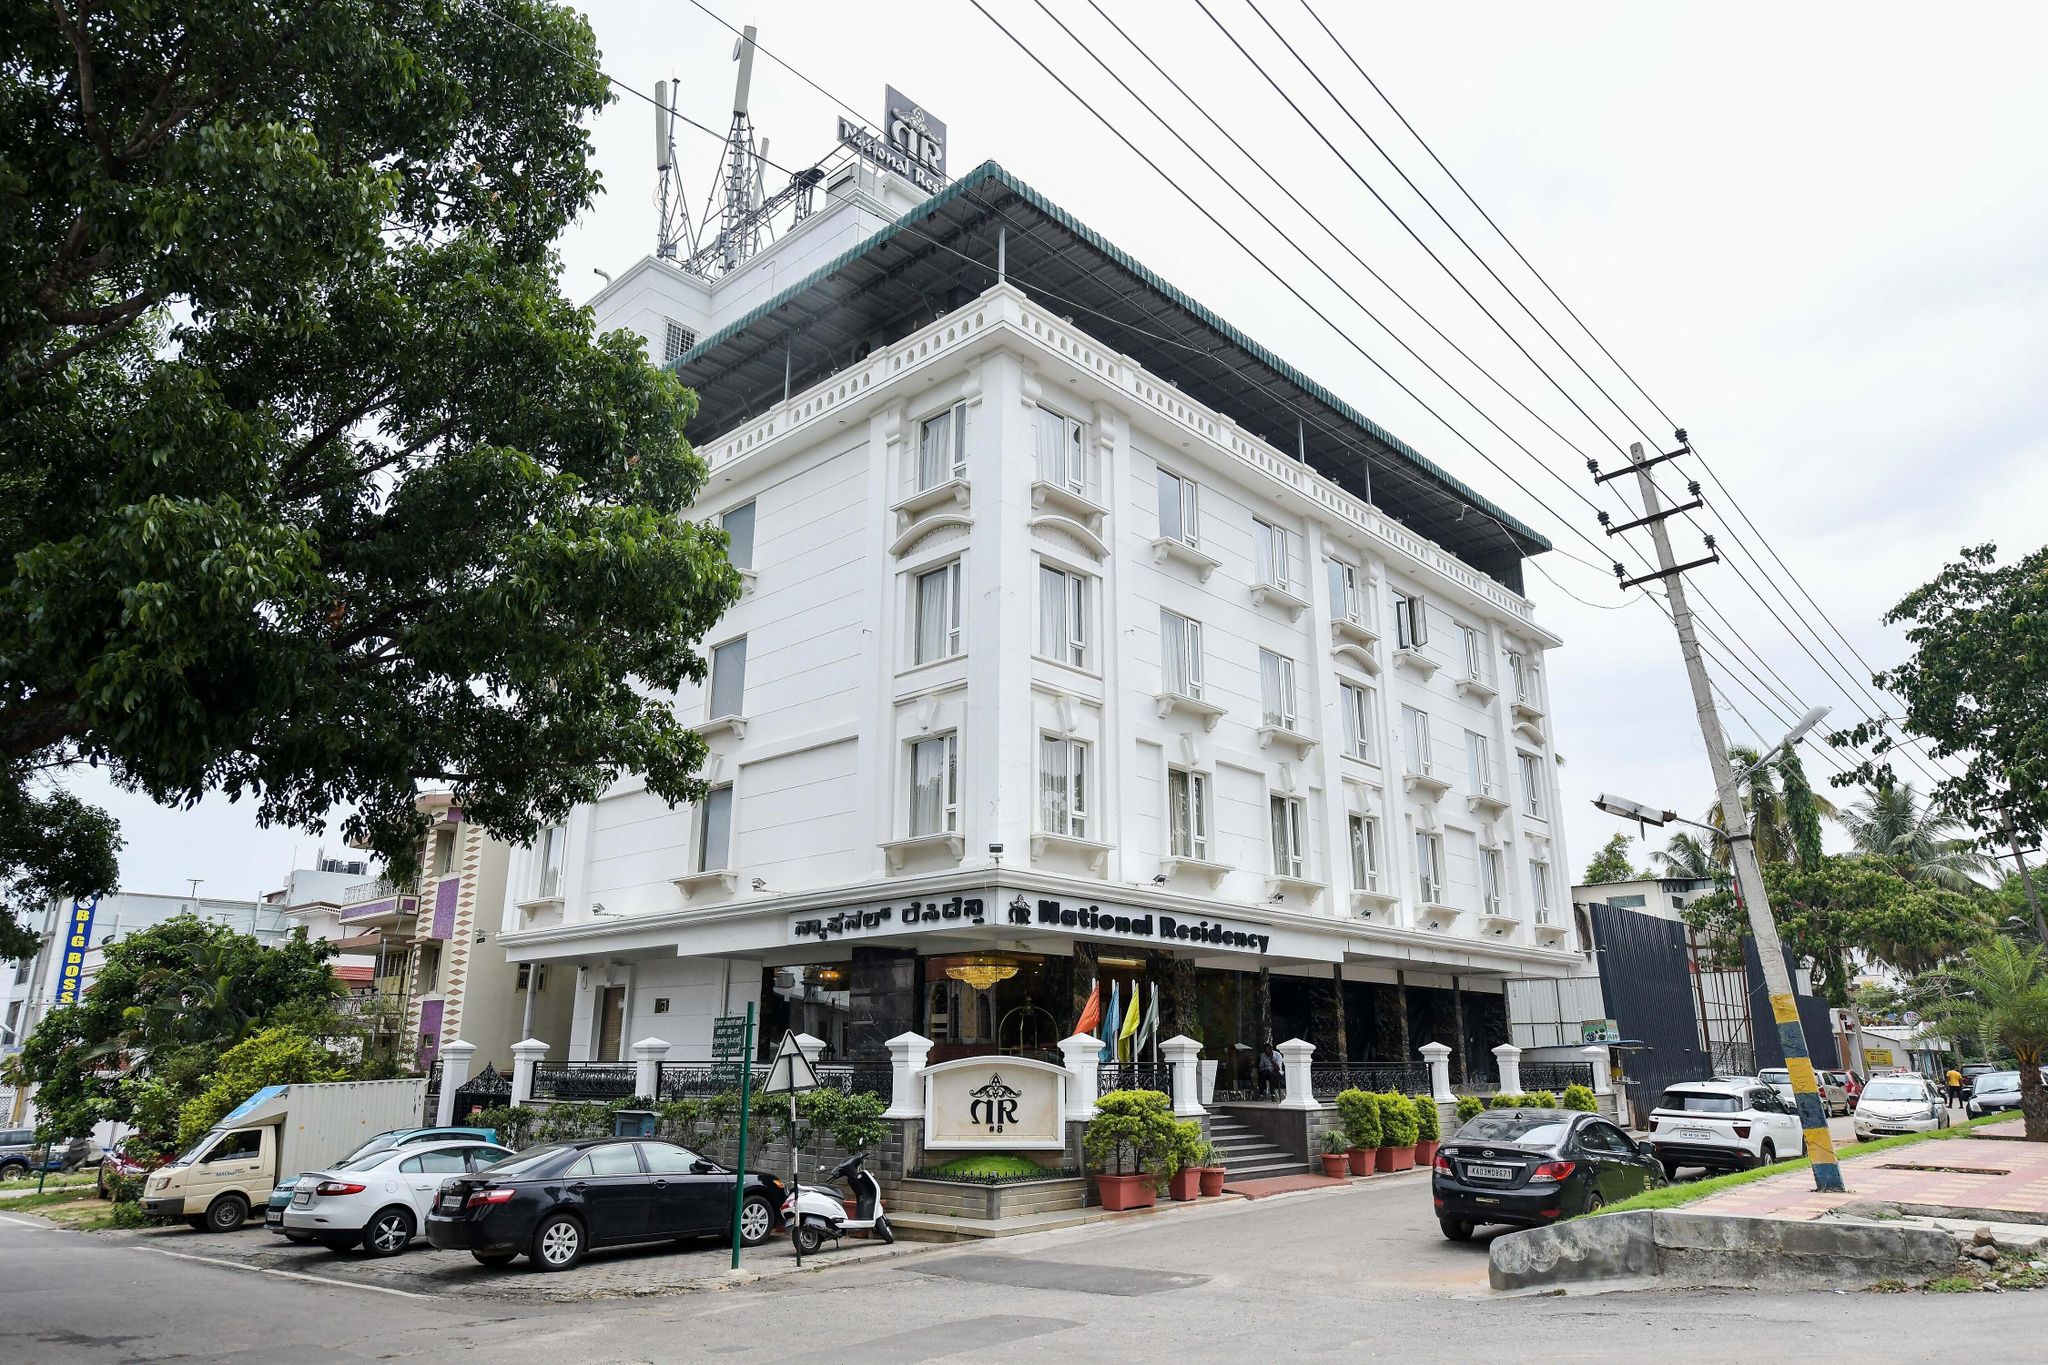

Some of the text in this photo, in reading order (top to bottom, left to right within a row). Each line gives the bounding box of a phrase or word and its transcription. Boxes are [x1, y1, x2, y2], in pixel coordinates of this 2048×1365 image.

[71, 909, 90, 947] BIG
[1037, 900, 1270, 954] National Residency
[61, 952, 81, 1003] BOSS
